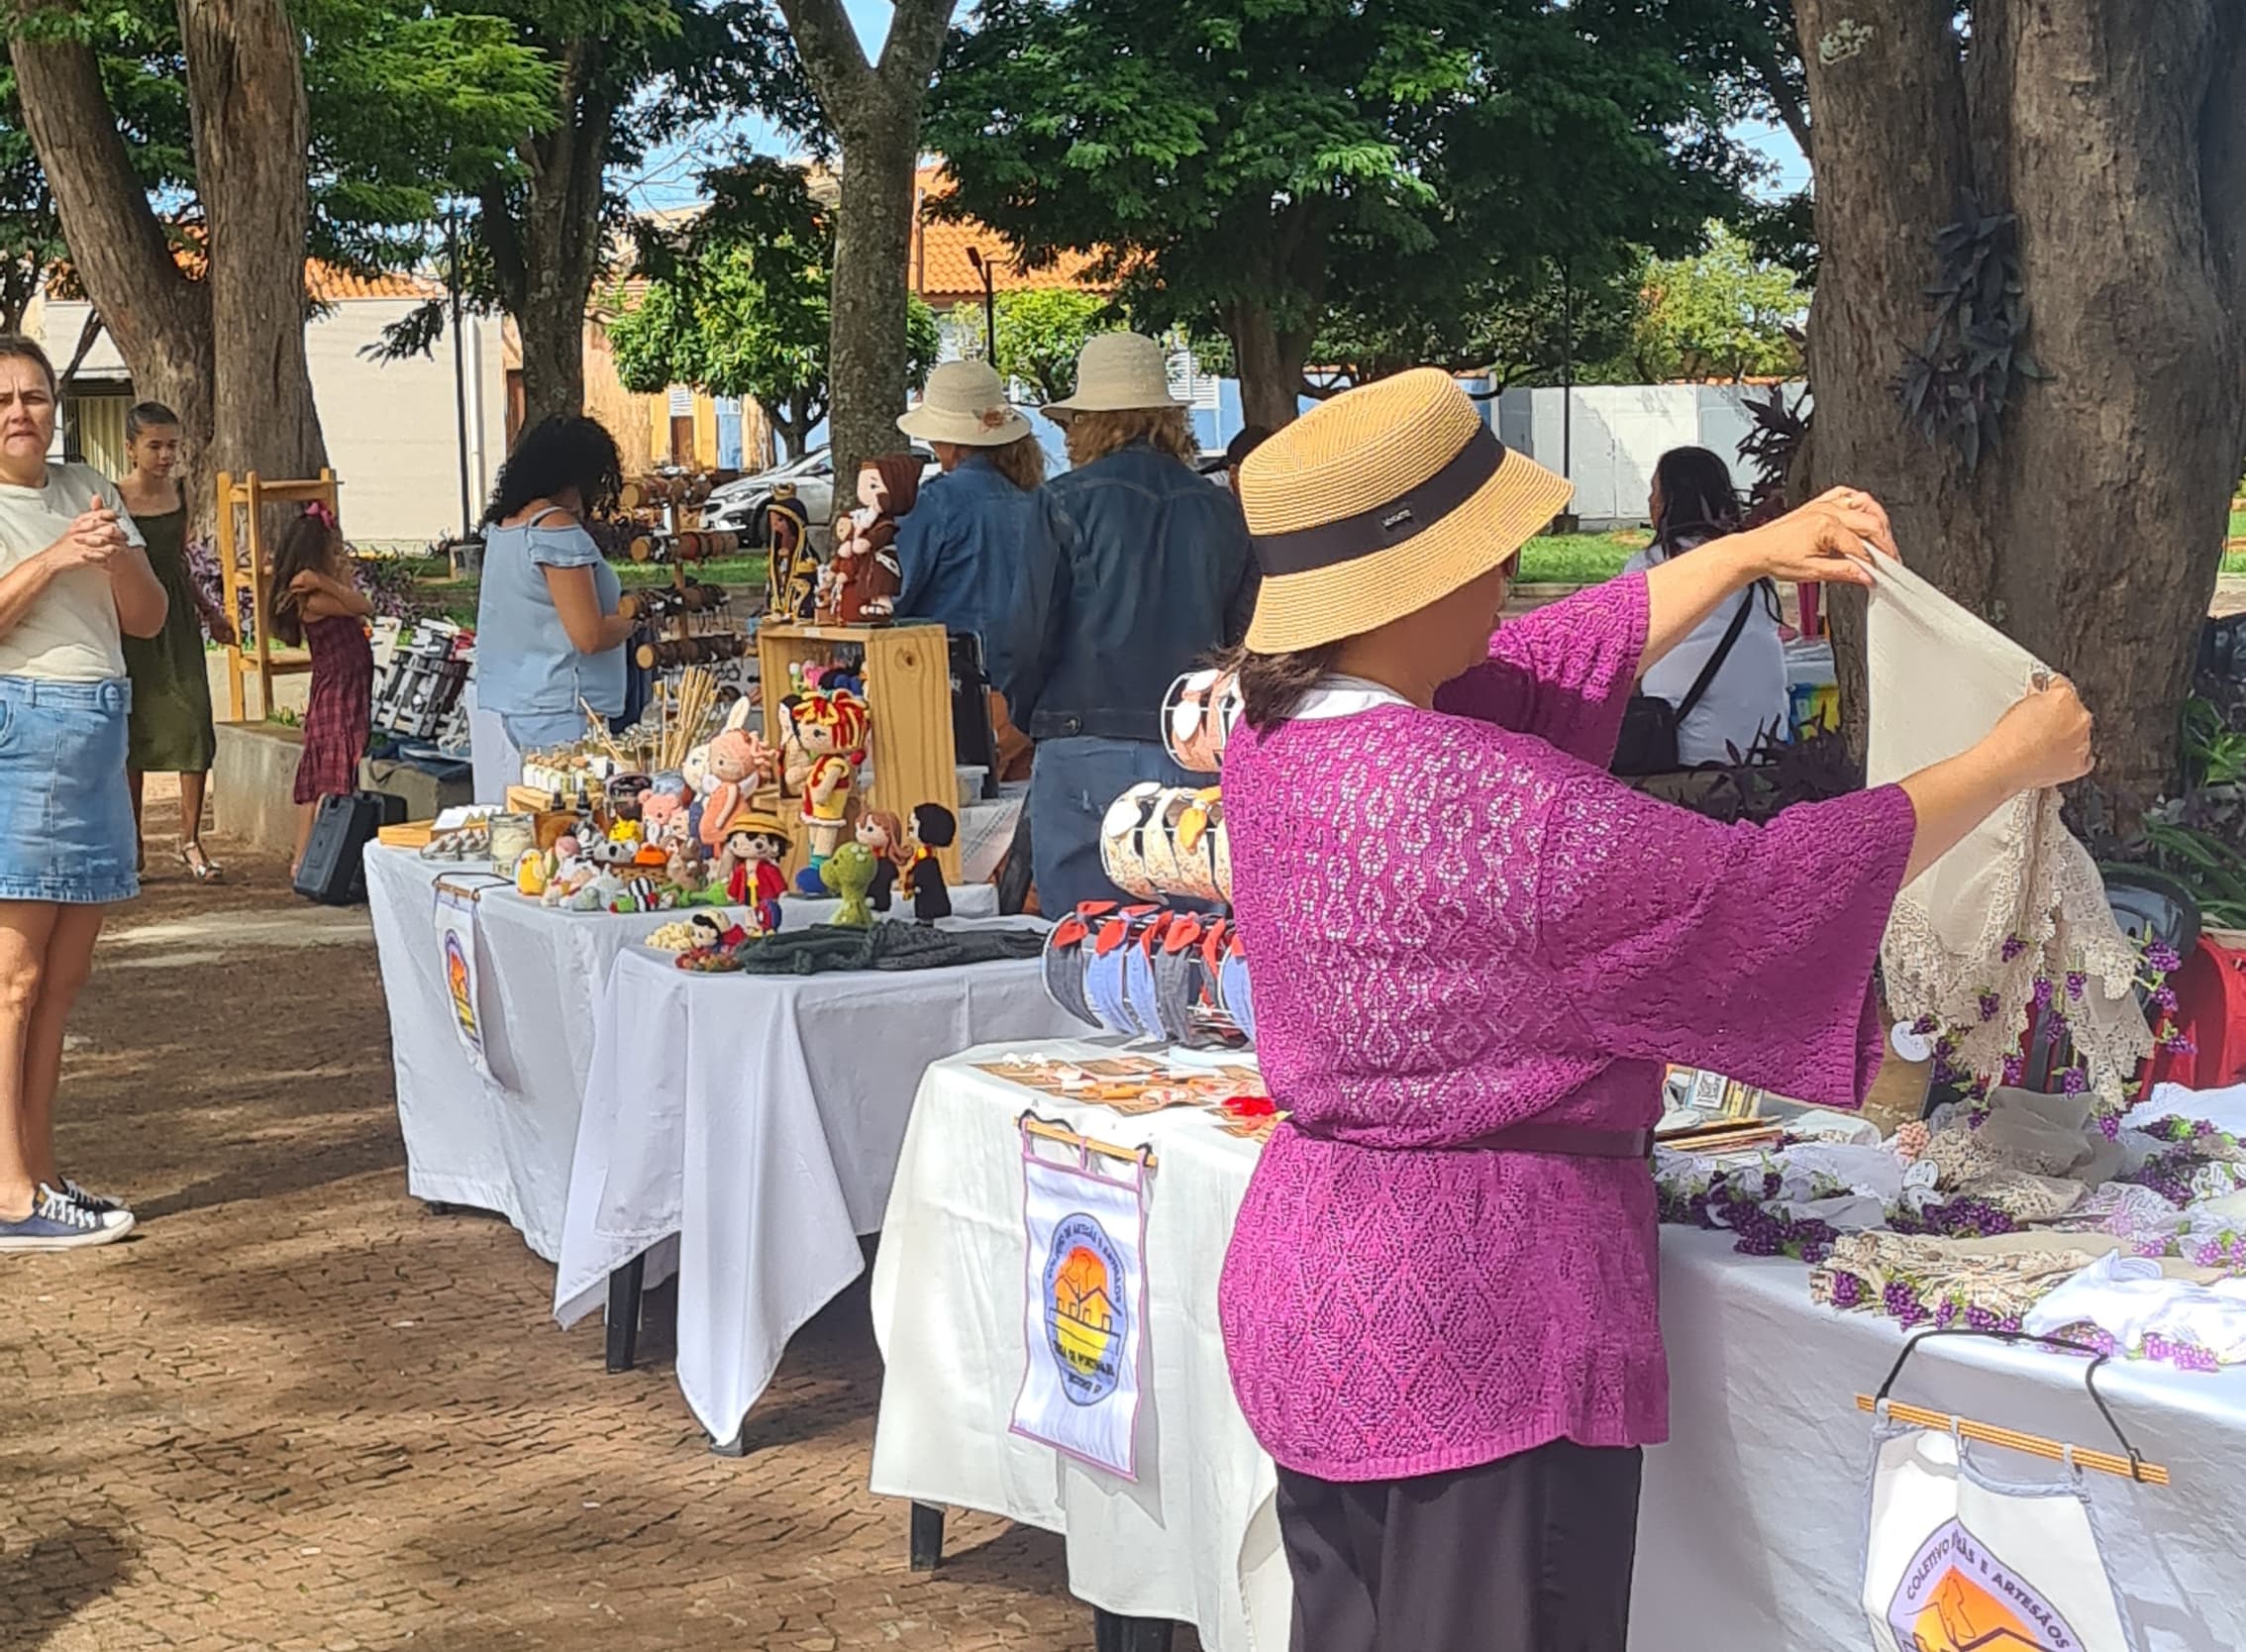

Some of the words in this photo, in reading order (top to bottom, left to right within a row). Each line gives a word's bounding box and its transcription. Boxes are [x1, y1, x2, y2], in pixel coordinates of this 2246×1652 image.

[1906, 1538, 1950, 1600] COLETIVO
[1980, 1558, 1989, 1575] E
[1991, 1572, 2071, 1649] ARTESÃOS
